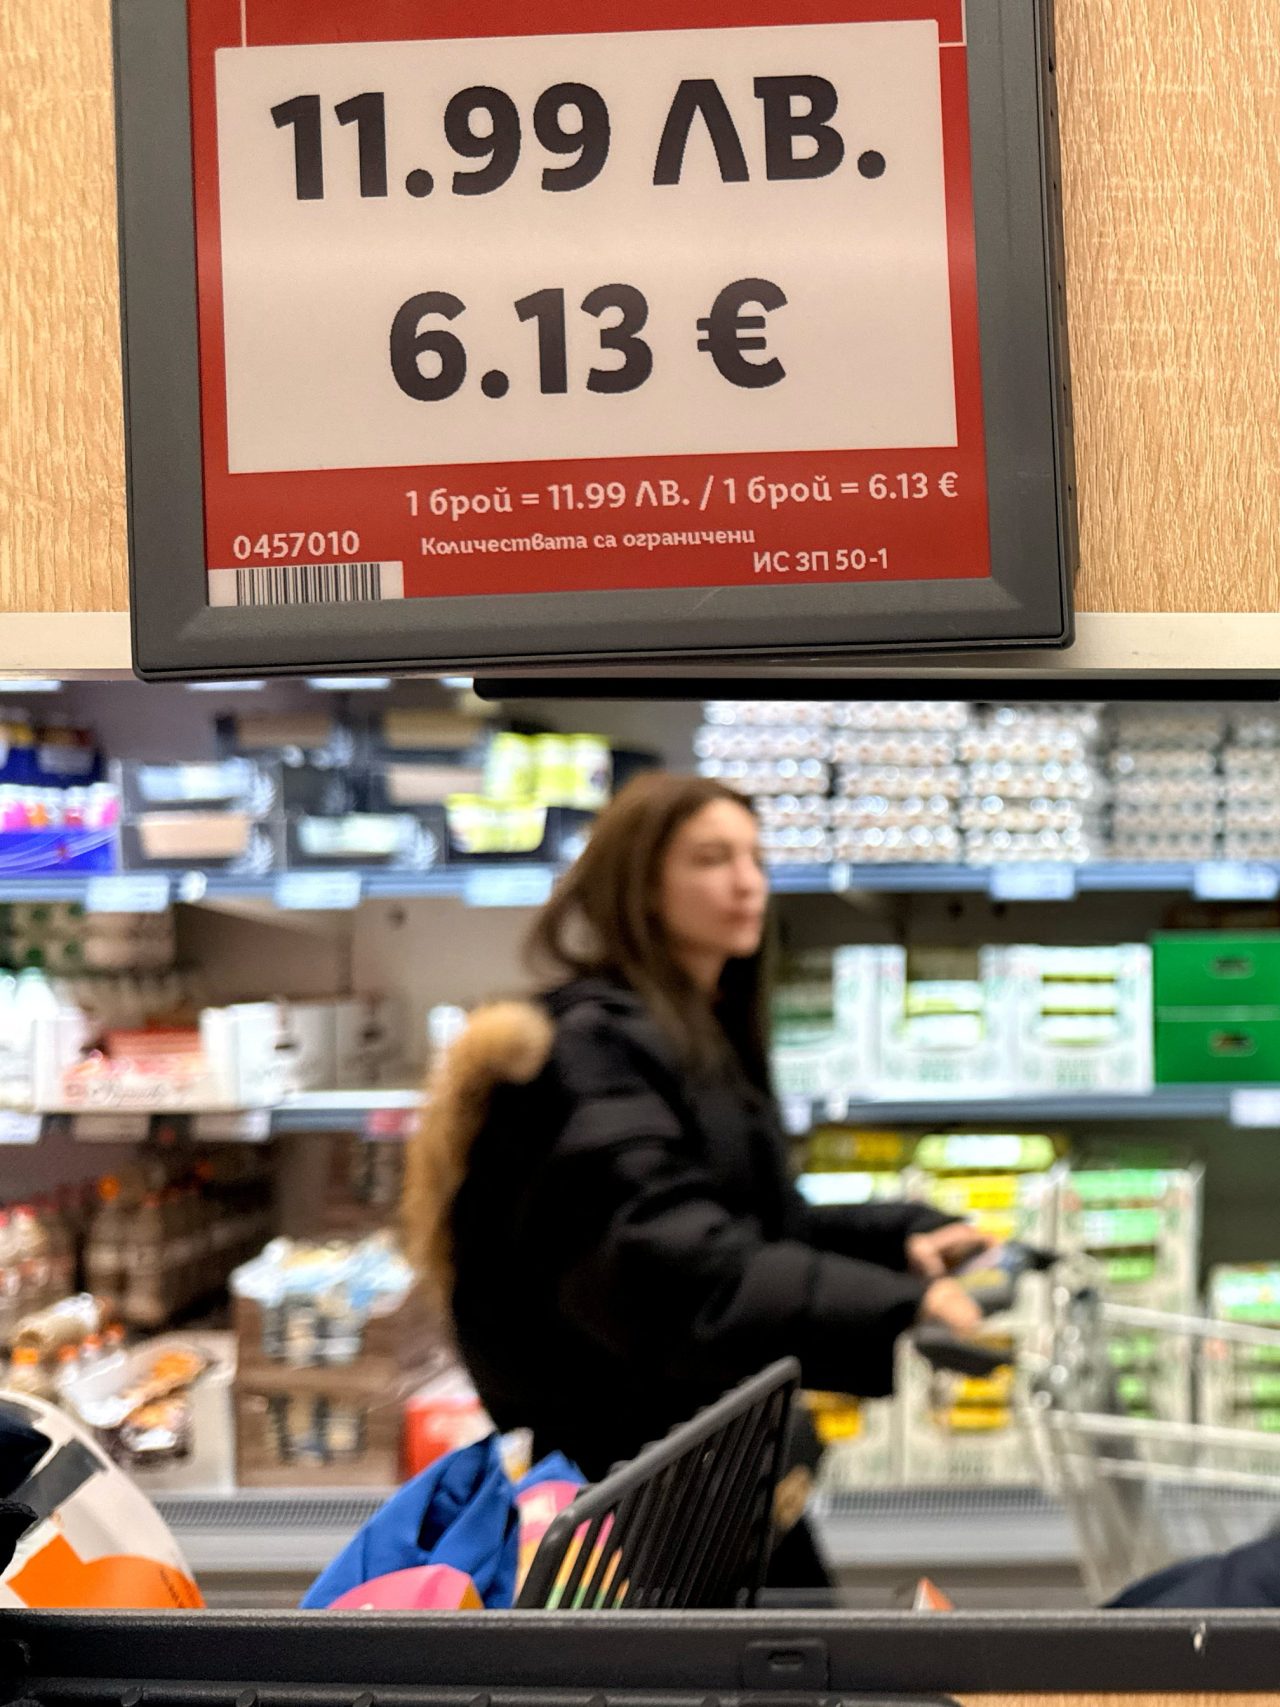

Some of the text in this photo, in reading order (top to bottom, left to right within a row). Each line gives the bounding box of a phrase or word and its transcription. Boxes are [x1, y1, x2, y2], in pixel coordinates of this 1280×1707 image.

[270, 74, 886, 201] 11.99 ЛВ.
[389, 277, 788, 402] 6.13 €
[405, 471, 958, 522] 1 брой = 11.99 ЛВ. / 1 брой = 6.13 €
[233, 530, 360, 560] 0457010
[421, 529, 755, 555] Количествата са ограничени
[753, 551, 790, 573] ИС
[835, 547, 888, 571] 50-1
